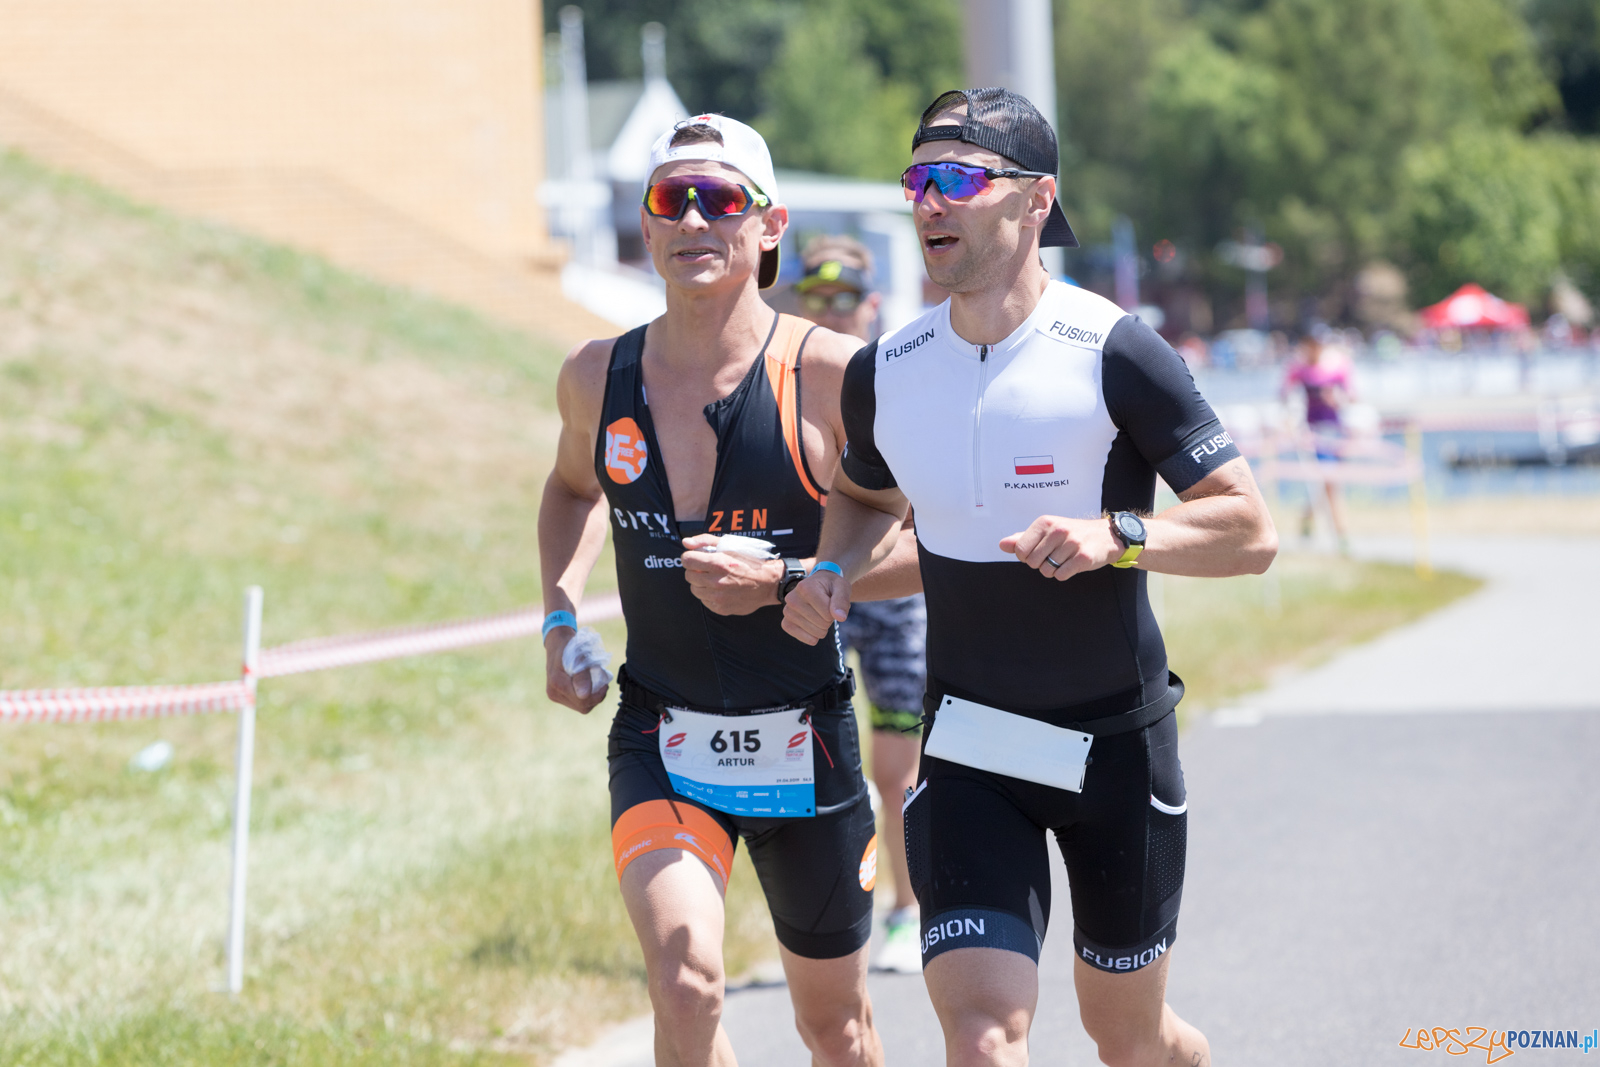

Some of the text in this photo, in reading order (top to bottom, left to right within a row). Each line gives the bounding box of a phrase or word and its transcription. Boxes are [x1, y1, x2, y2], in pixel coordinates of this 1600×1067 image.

[1049, 320, 1103, 345] FUSION
[885, 328, 935, 362] FUSION
[1004, 479, 1069, 490] P.KANIEWSKI
[708, 508, 767, 532] ZEN
[710, 729, 761, 753] 615
[718, 758, 755, 767] ARTUR
[1082, 937, 1167, 969] FUSION
